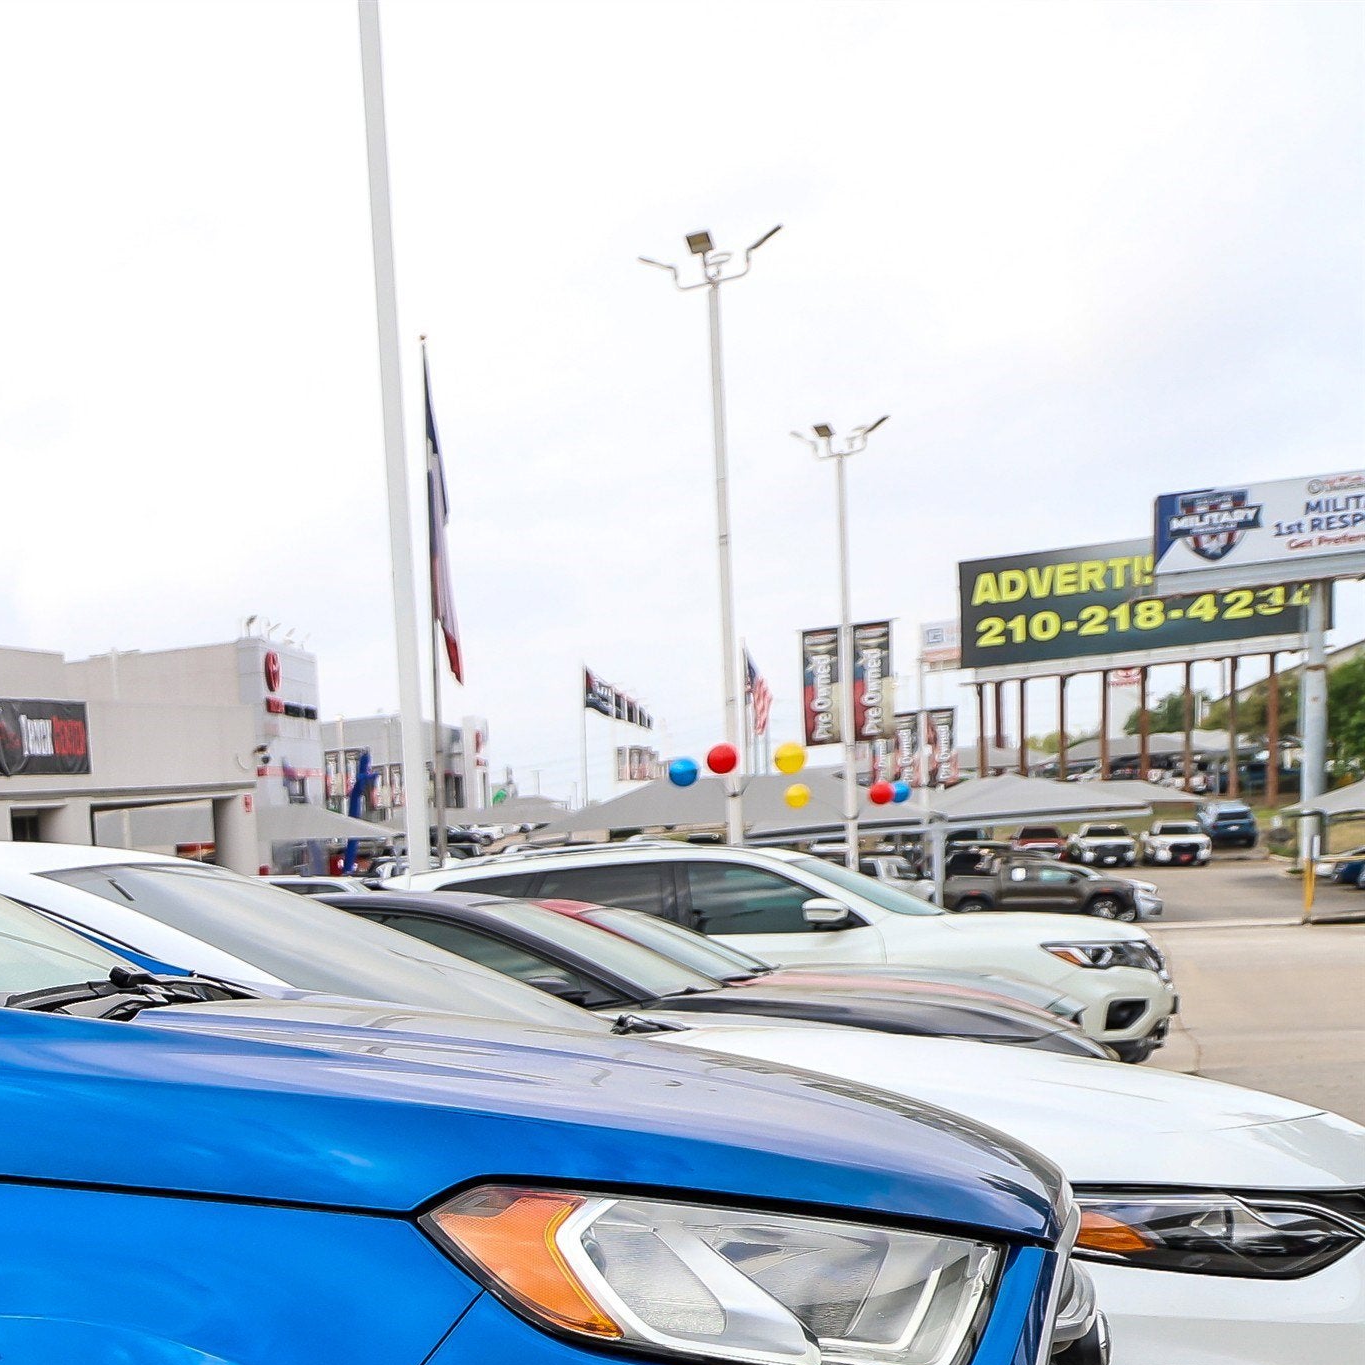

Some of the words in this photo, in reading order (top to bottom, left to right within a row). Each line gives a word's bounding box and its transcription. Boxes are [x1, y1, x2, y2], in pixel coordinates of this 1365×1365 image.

[1304, 494, 1365, 515] MILIT
[1274, 520, 1304, 537] 1st
[1311, 512, 1365, 532] RESP
[810, 654, 833, 712] Owned
[860, 649, 883, 707] Owned
[812, 711, 834, 741] Pre
[861, 707, 883, 736] Pre
